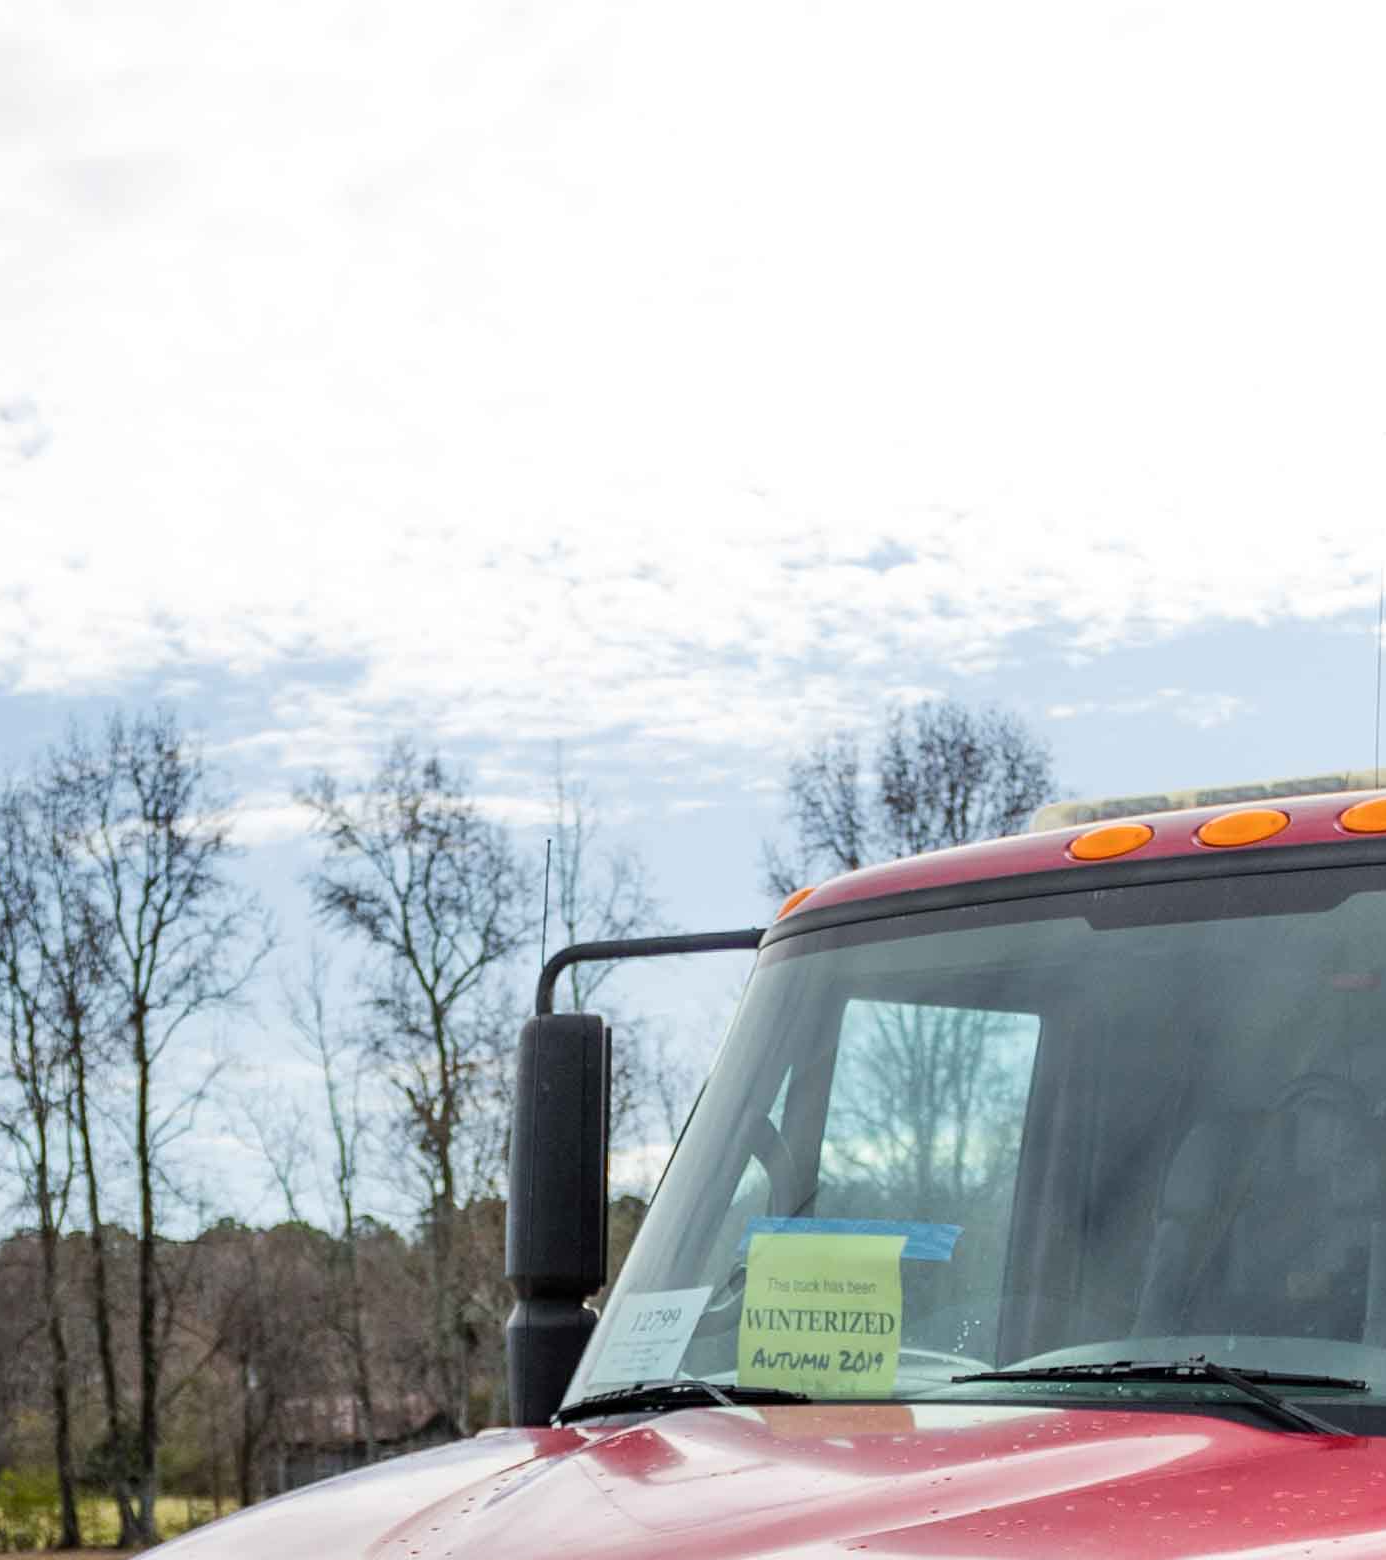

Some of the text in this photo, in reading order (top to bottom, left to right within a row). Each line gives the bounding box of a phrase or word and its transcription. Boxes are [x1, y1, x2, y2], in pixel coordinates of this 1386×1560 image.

[846, 1279, 877, 1295] been
[745, 1307, 896, 1336] WINTERIZED
[750, 1347, 884, 1373] AUTUMN 2019
